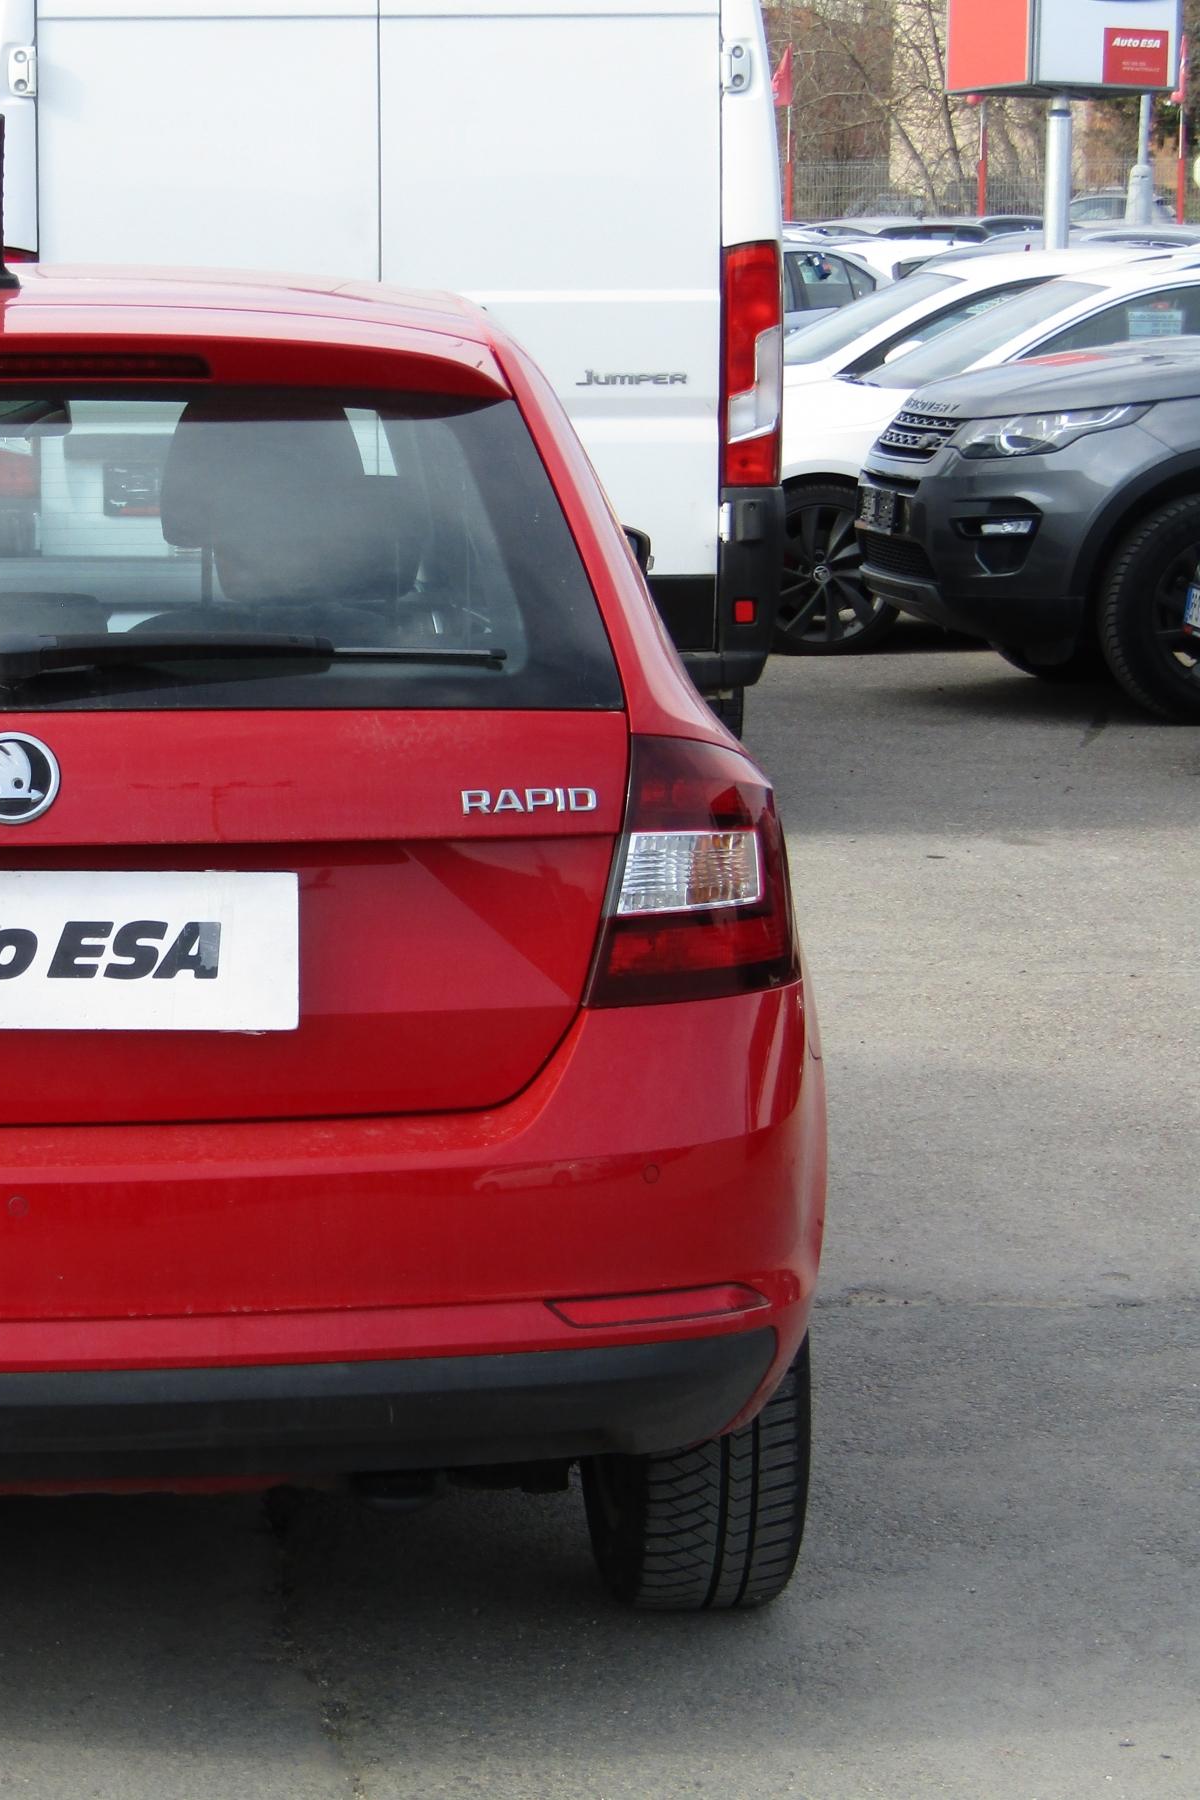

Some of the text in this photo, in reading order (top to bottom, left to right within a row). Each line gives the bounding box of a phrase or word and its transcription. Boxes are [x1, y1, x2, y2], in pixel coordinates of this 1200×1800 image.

[1112, 37, 1161, 48] Auto ESA
[576, 370, 687, 386] JUMPER
[461, 787, 597, 814] RAPID
[46, 920, 222, 980] ESA
